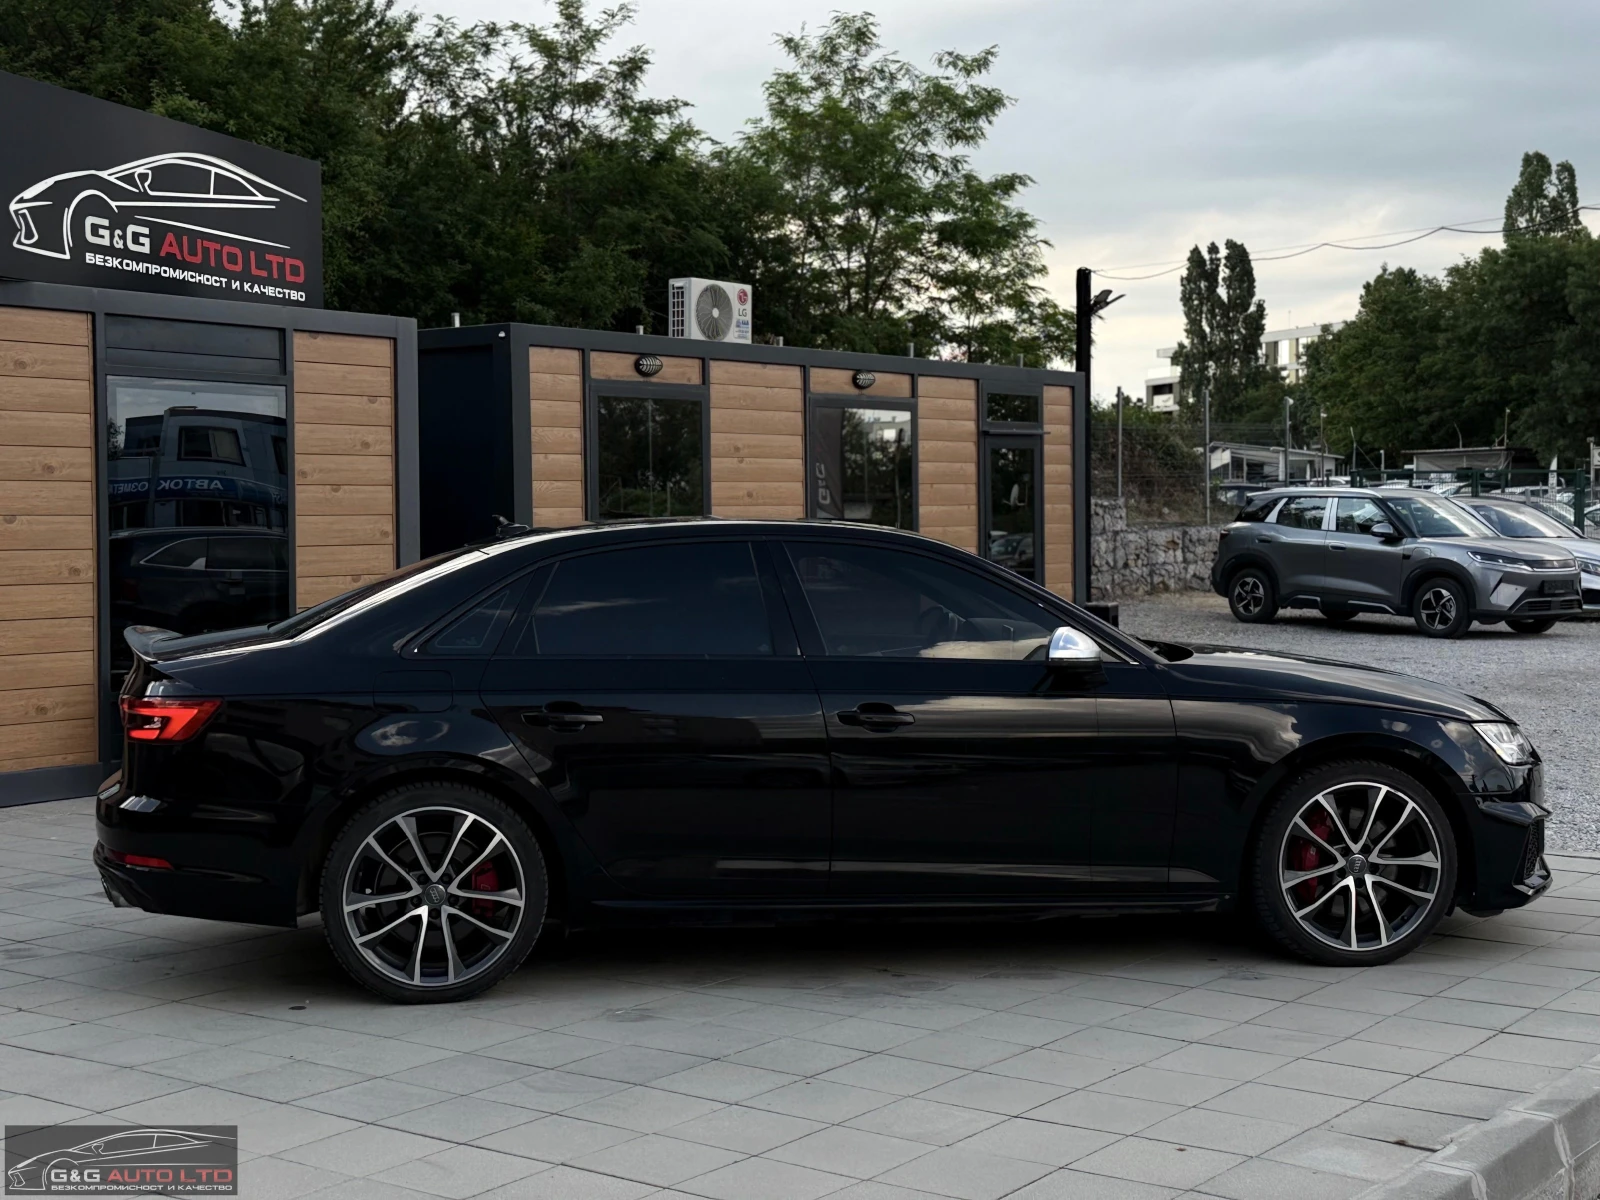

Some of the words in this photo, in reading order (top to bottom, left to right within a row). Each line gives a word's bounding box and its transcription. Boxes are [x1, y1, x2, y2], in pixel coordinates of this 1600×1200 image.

[85, 215, 150, 254] G&G
[160, 232, 243, 272] AUTO
[250, 254, 305, 283] LTD
[85, 252, 228, 289] БЕЗКОМПРОМИСНОСТ
[231, 280, 240, 290] И
[244, 281, 306, 301] КАЧЕСТВО
[738, 308, 747, 317] LG
